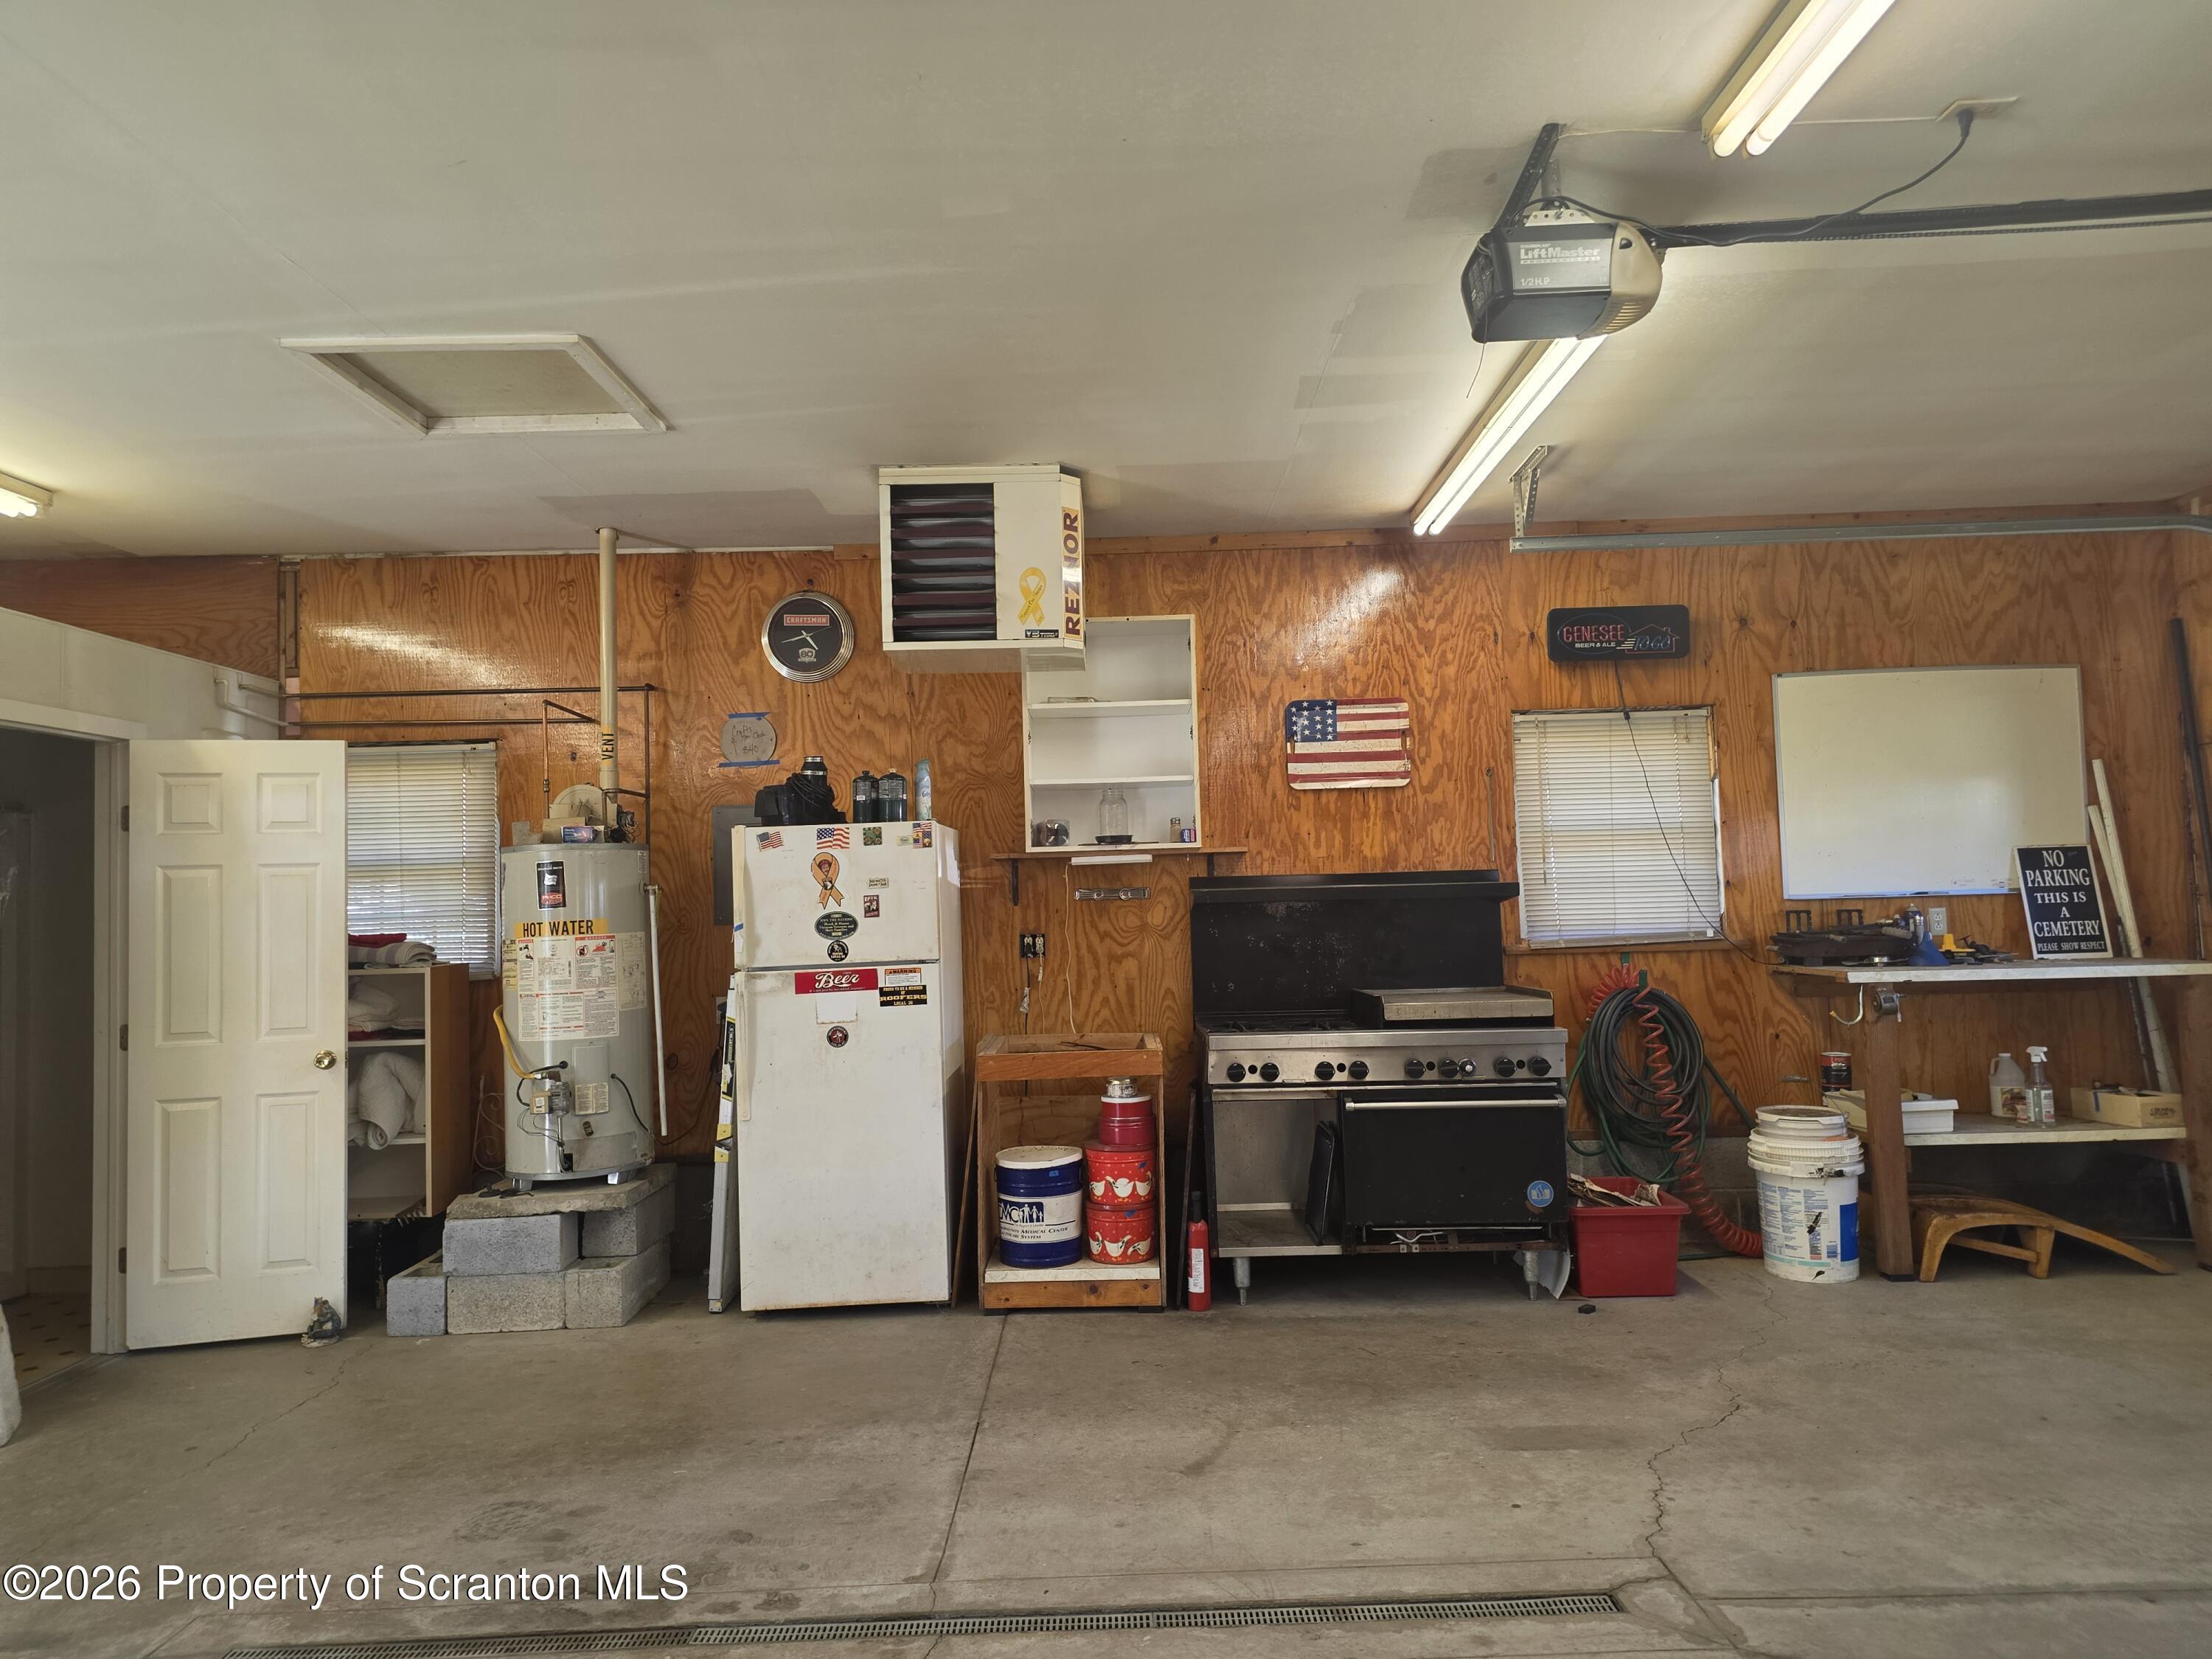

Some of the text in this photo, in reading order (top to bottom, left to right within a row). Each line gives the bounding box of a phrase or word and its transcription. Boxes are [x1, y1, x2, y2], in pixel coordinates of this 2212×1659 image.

[1520, 247, 1600, 259] LiftMaster
[1563, 625, 1625, 642] GENESEE
[602, 732, 614, 760] VENT
[2042, 849, 2065, 867] NO
[2025, 868, 2090, 887] PARKING
[2034, 891, 2087, 904] THIS IS
[2060, 906, 2070, 918] A
[523, 919, 594, 937] HOT WATER
[2034, 920, 2100, 937] CEMETERY
[2037, 941, 2104, 951] PLEASE SHOW RESPECT
[815, 972, 860, 989] Beer
